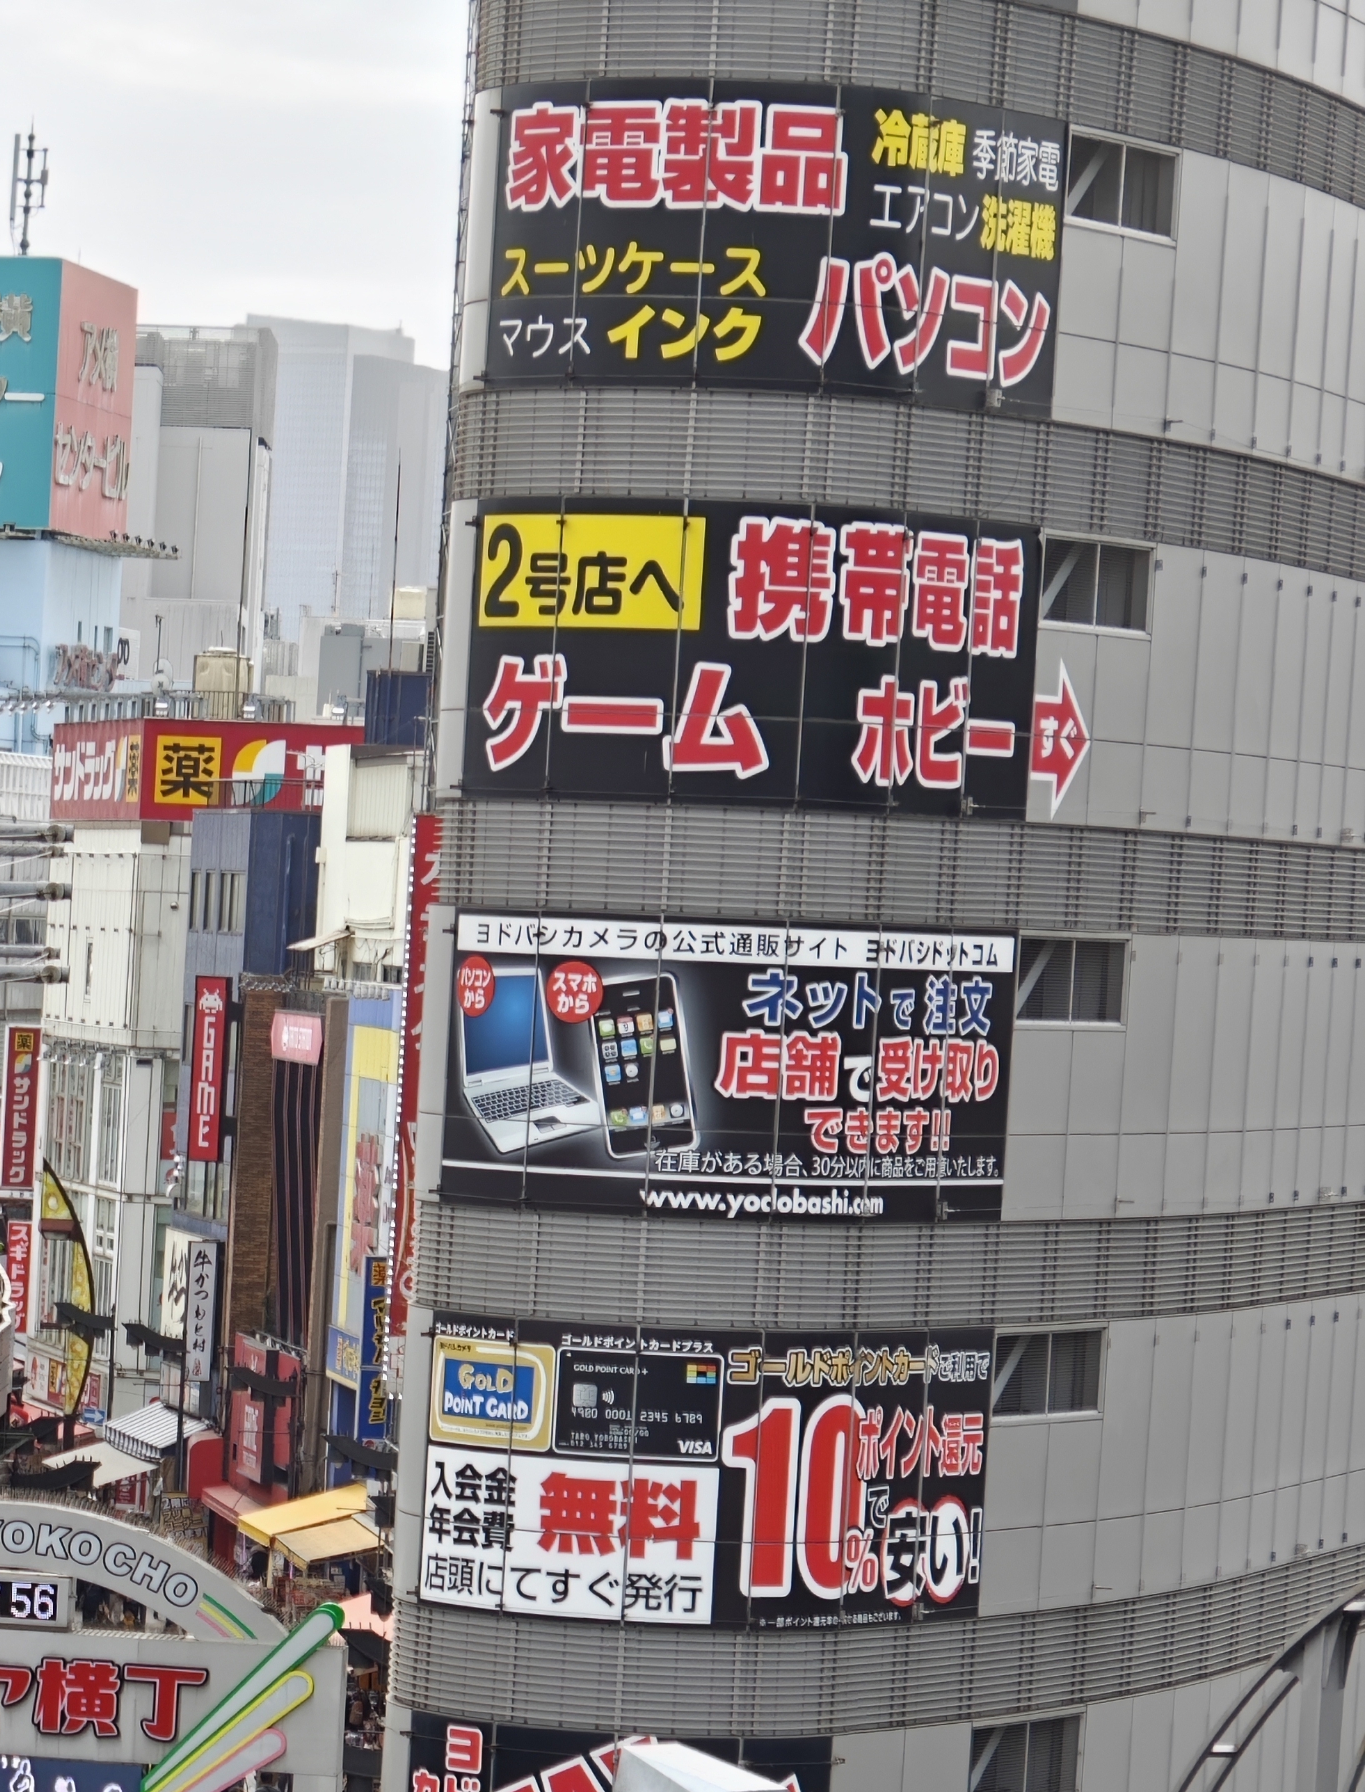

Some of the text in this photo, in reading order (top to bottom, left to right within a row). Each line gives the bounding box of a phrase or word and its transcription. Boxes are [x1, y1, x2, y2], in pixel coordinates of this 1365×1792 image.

[505, 99, 848, 216] 家電製品
[871, 107, 968, 179] 冷蔵庫
[972, 130, 1062, 193] 季節家電
[869, 182, 979, 242] エアコン
[979, 192, 1057, 262] 洗濯機
[500, 241, 767, 297] スーツケース
[498, 317, 591, 358] マウス
[606, 305, 763, 362] インク
[797, 251, 1051, 388] パソコン
[77, 320, 118, 393] アメ横
[484, 522, 684, 619] 2号店へ
[728, 515, 1024, 659] 携帯電話
[484, 654, 769, 780] ゲーム
[852, 675, 1016, 789] ホビー
[1039, 715, 1079, 760] すぐ
[52, 738, 119, 803] サンドラッグ
[127, 741, 140, 800] 薬
[159, 740, 216, 799] 薬
[476, 922, 999, 968] ヨドバシカメラの公式通販サイト ヨドバシドットコム
[459, 967, 492, 988] パソコン
[463, 988, 486, 1009] から
[552, 972, 598, 993] スマホ
[557, 994, 590, 1014] から
[742, 969, 994, 1036] ネットで注文
[15, 1032, 34, 1051] 薬
[714, 1030, 999, 1101] 店舗で受け取り
[197, 1016, 219, 1147] GAME
[8, 1077, 31, 1184] サンドラッグ
[640, 1188, 884, 1218] www.yodobashi.com
[9, 1226, 29, 1331] スギドラッグ
[193, 1249, 212, 1352] 牛かつもと村
[435, 1322, 515, 1341] ゴールドポイントカード
[561, 1334, 714, 1353] ゴールドポイントカードプラス
[458, 1363, 514, 1393] GOLD
[574, 1363, 618, 1374] GOLD POINT
[727, 1344, 991, 1388] ゴールドポイントカードご利用で
[444, 1391, 529, 1420] POINT CARD
[640, 1410, 669, 1422] 2345
[675, 1411, 703, 1424] 6789
[677, 1440, 713, 1454] VISA
[857, 1404, 984, 1480] ポイント還元
[431, 1461, 517, 1506] 入会金
[429, 1505, 515, 1553] 年会費
[538, 1471, 701, 1560] 無料
[424, 1554, 704, 1613] 店頭にてすぐ発行
